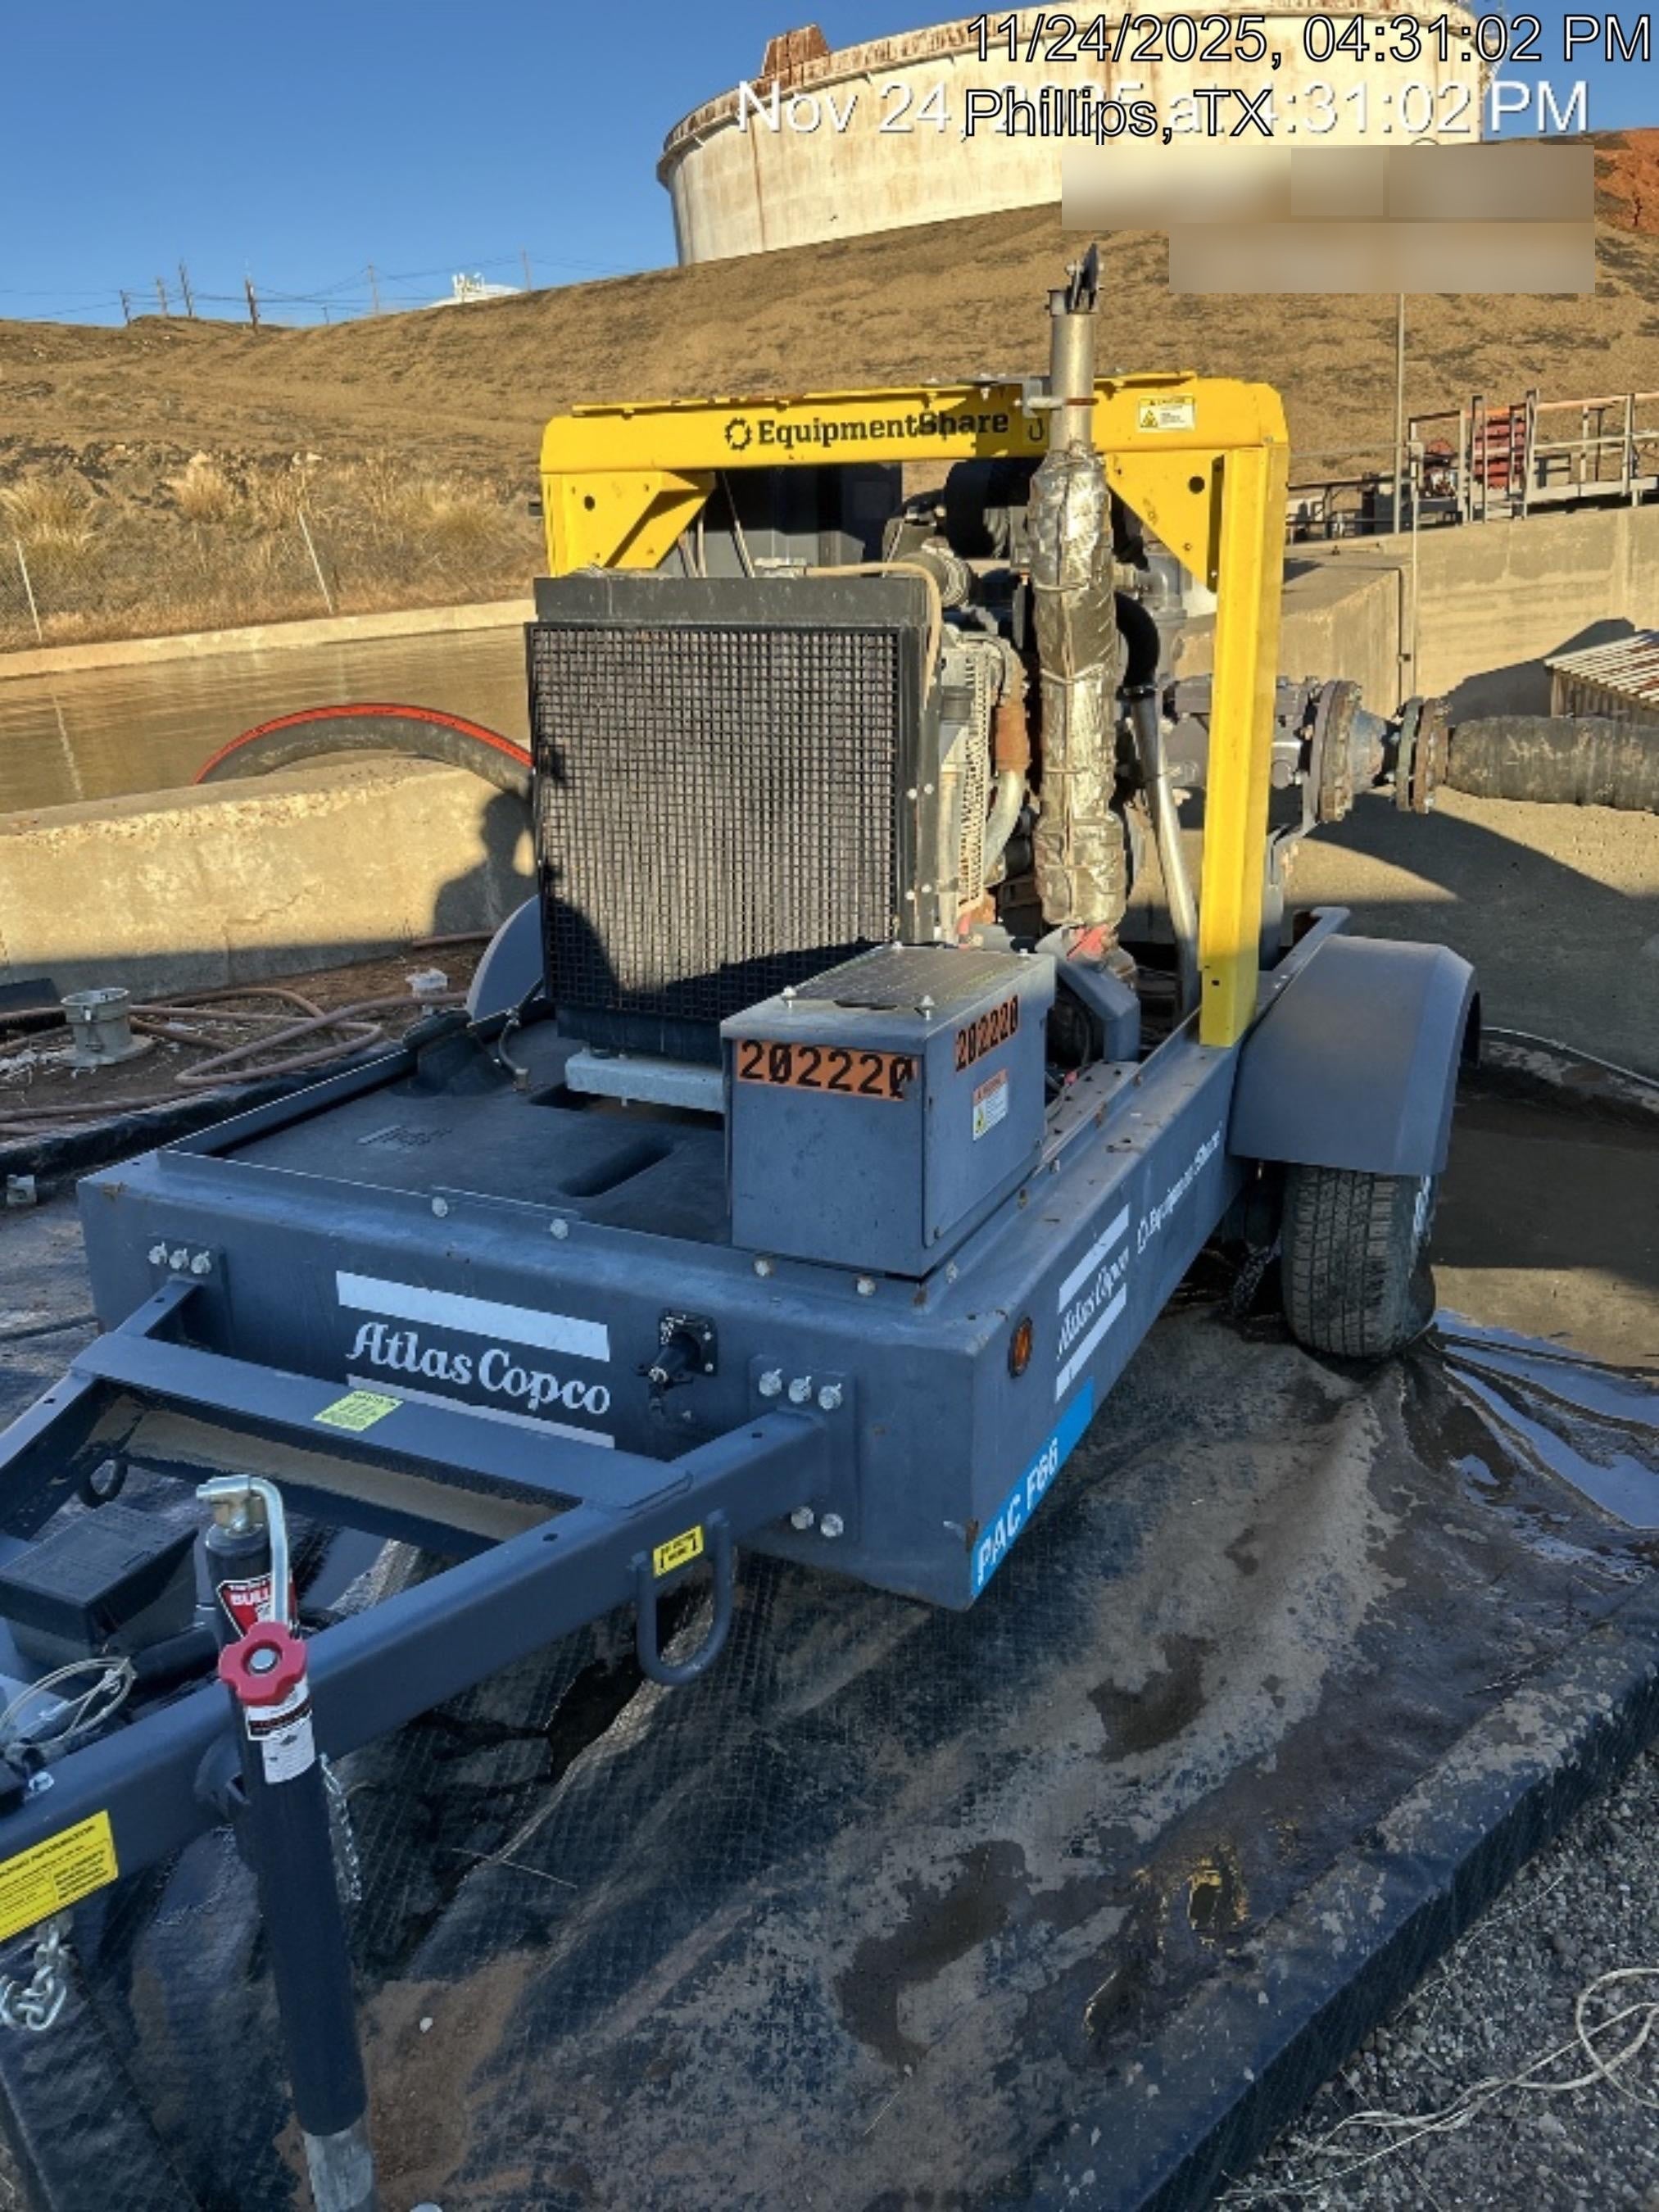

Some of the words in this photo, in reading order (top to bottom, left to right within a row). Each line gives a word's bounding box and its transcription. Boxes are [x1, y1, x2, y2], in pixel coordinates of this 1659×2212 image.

[757, 412, 1009, 447] EquipmentShare
[740, 1039, 915, 1099] 202220
[956, 995, 1019, 1072] 202220
[346, 1321, 473, 1385] Atlas
[478, 1348, 611, 1415] Copco
[977, 1494, 1021, 1587] PAC
